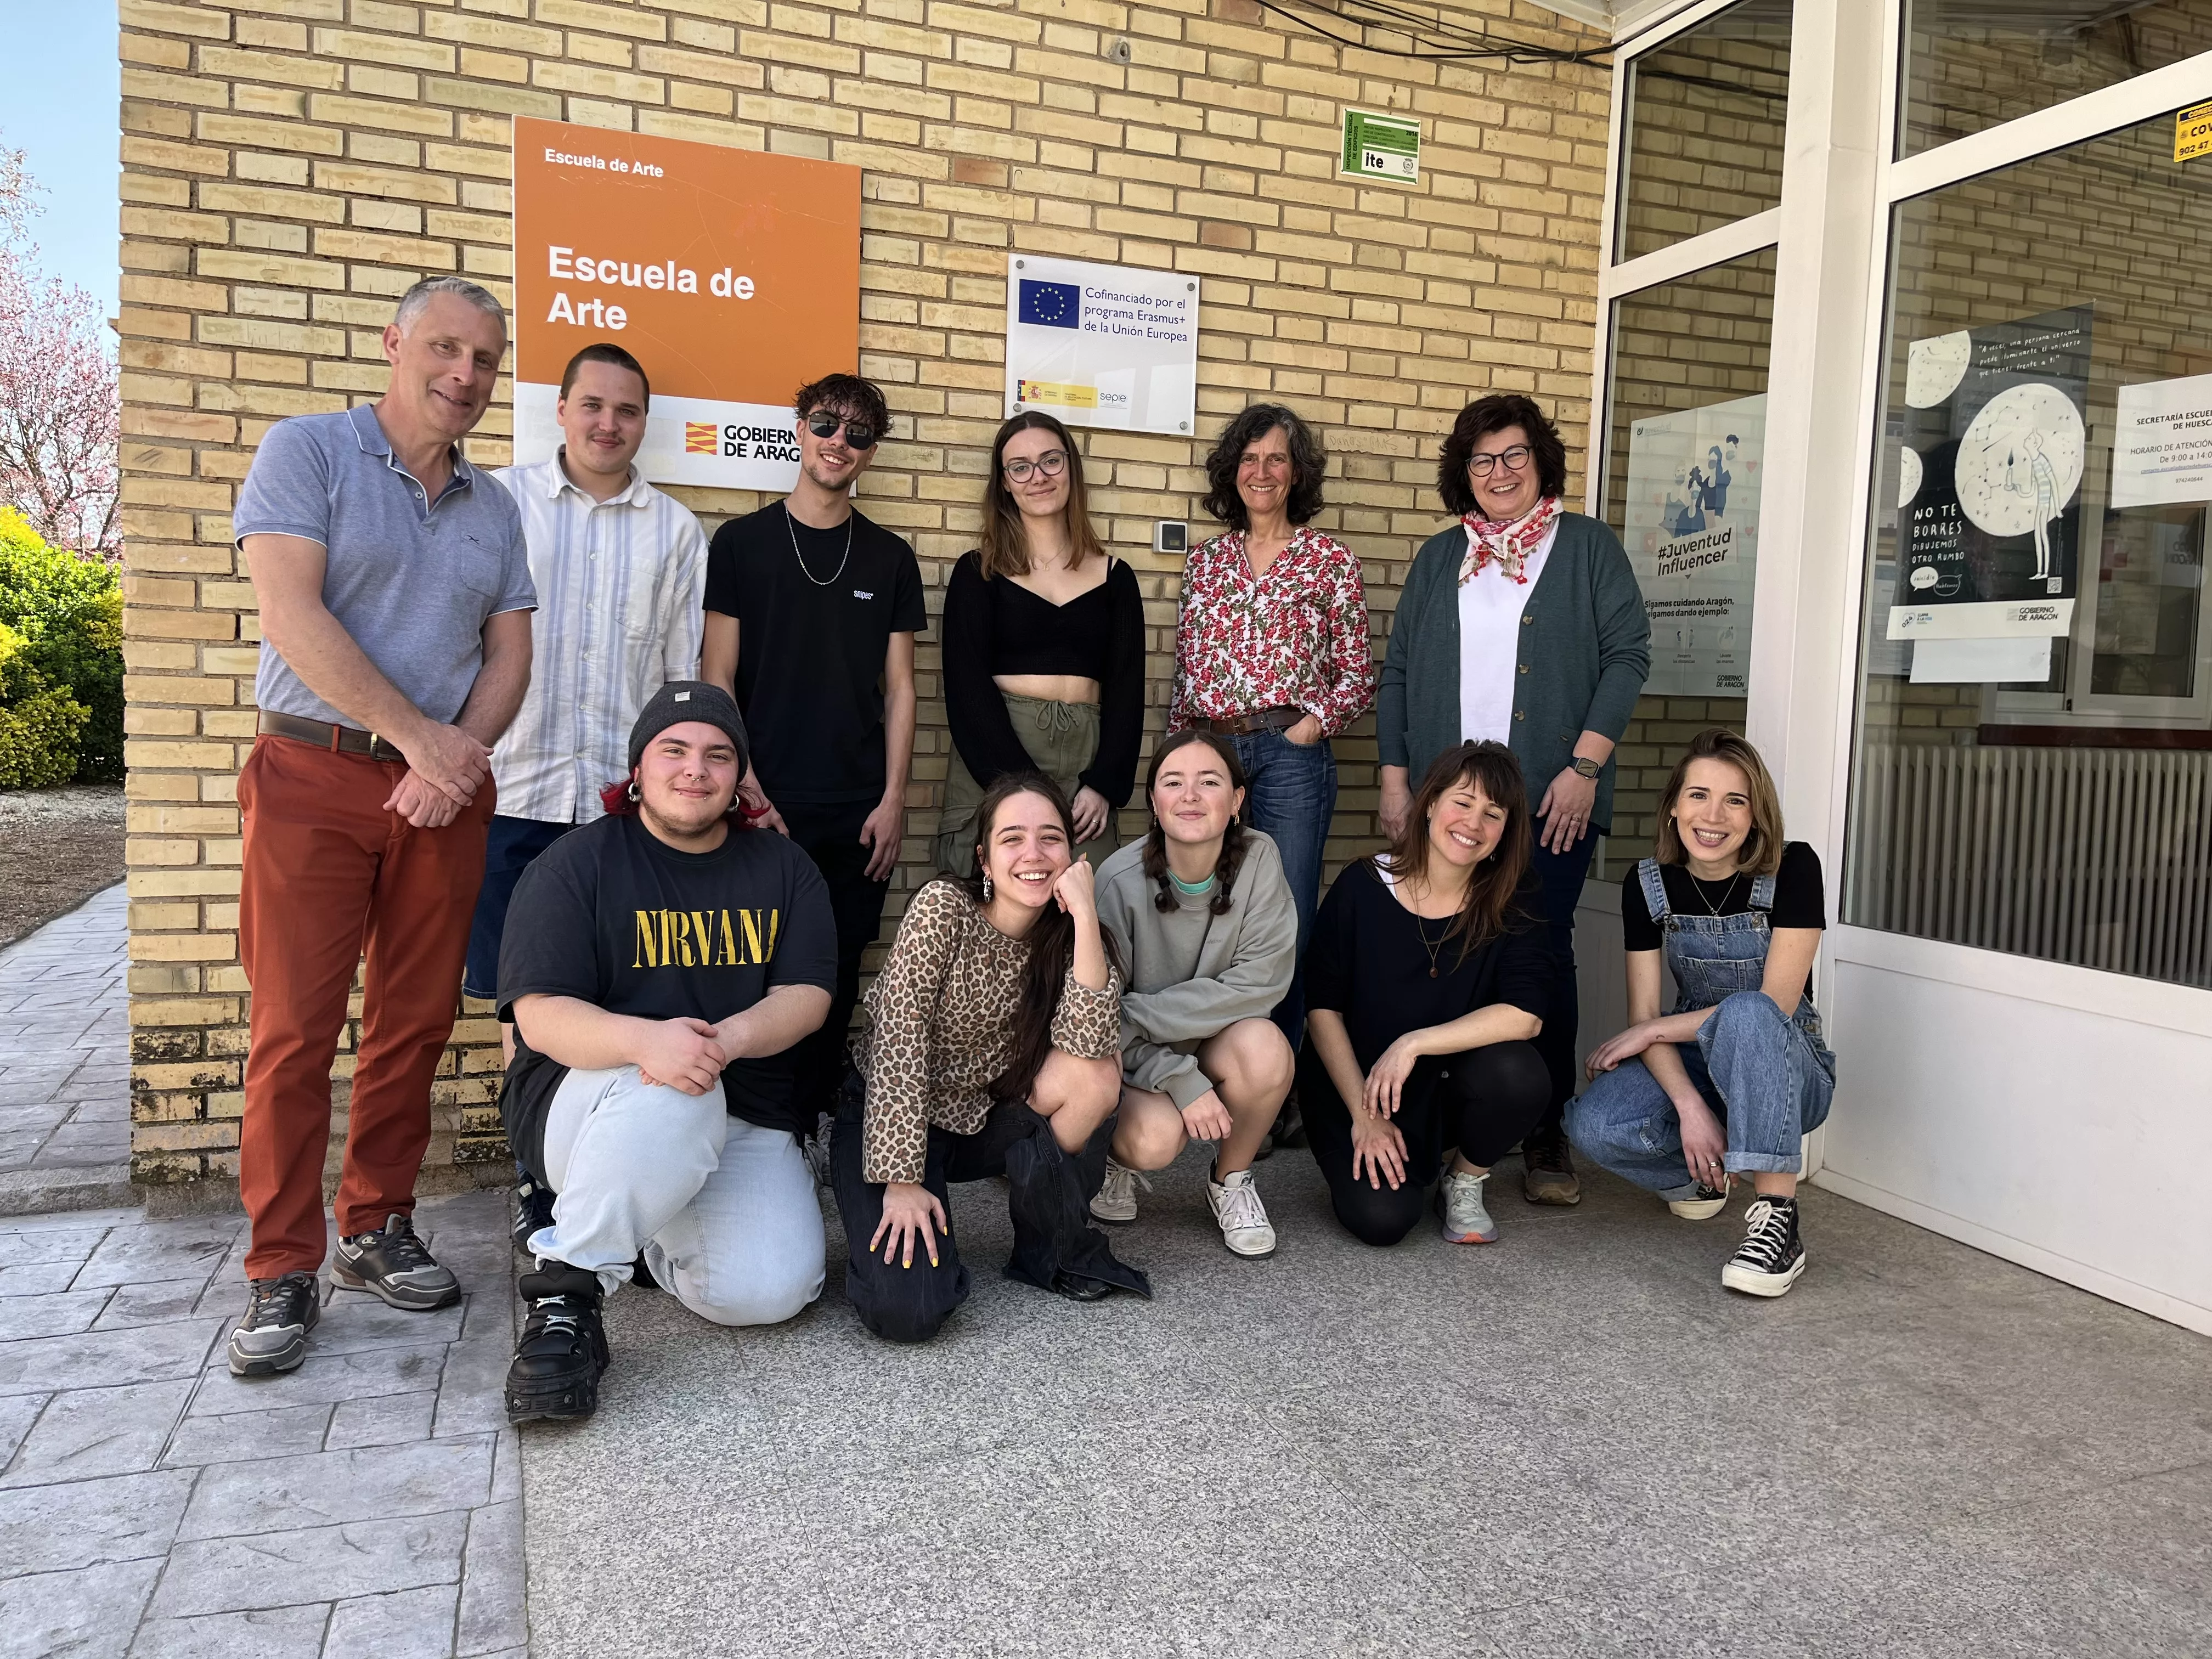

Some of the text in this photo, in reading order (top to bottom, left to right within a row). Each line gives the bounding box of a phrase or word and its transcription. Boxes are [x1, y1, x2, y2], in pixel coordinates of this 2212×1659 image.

[2179, 140, 2209, 156] 902 47
[545, 148, 664, 178] Escuela de Arte
[1365, 152, 1384, 168] ite
[549, 245, 754, 300] Escuela de
[1085, 287, 1186, 309] Cofinanciado por el
[547, 292, 627, 330] Arte
[1085, 306, 1186, 325] programa Erasmus+
[1085, 321, 1188, 343] de la Unión Europea
[2024, 335, 2049, 346] persona
[2053, 328, 2080, 338] cercana
[1979, 355, 1997, 366] puede
[2001, 347, 2037, 360] iluminarte
[2051, 340, 2080, 351] universo
[1992, 365, 2012, 374] tienes
[2017, 360, 2037, 370] frente
[1099, 393, 1126, 403] sepie
[2136, 409, 2212, 426] SECRETARÍA ESCUEL
[724, 425, 797, 445] GOBIERN
[724, 442, 800, 462] DE ARAG
[2130, 439, 2212, 455] HORARIO DE ATENCIÓN
[2171, 454, 2187, 462] 9:00
[2196, 451, 2212, 460] 14:0
[1914, 503, 1957, 520] NO TE
[1914, 521, 1962, 538] BORRES
[1657, 527, 1732, 561] #Juventud
[1658, 549, 1728, 577] Influencer
[1912, 551, 1965, 564] OTRO RUMBO
[1645, 596, 1734, 610] Sigamos cuidando Aragón,
[1647, 607, 1730, 619] sigamos dando ejemplo:
